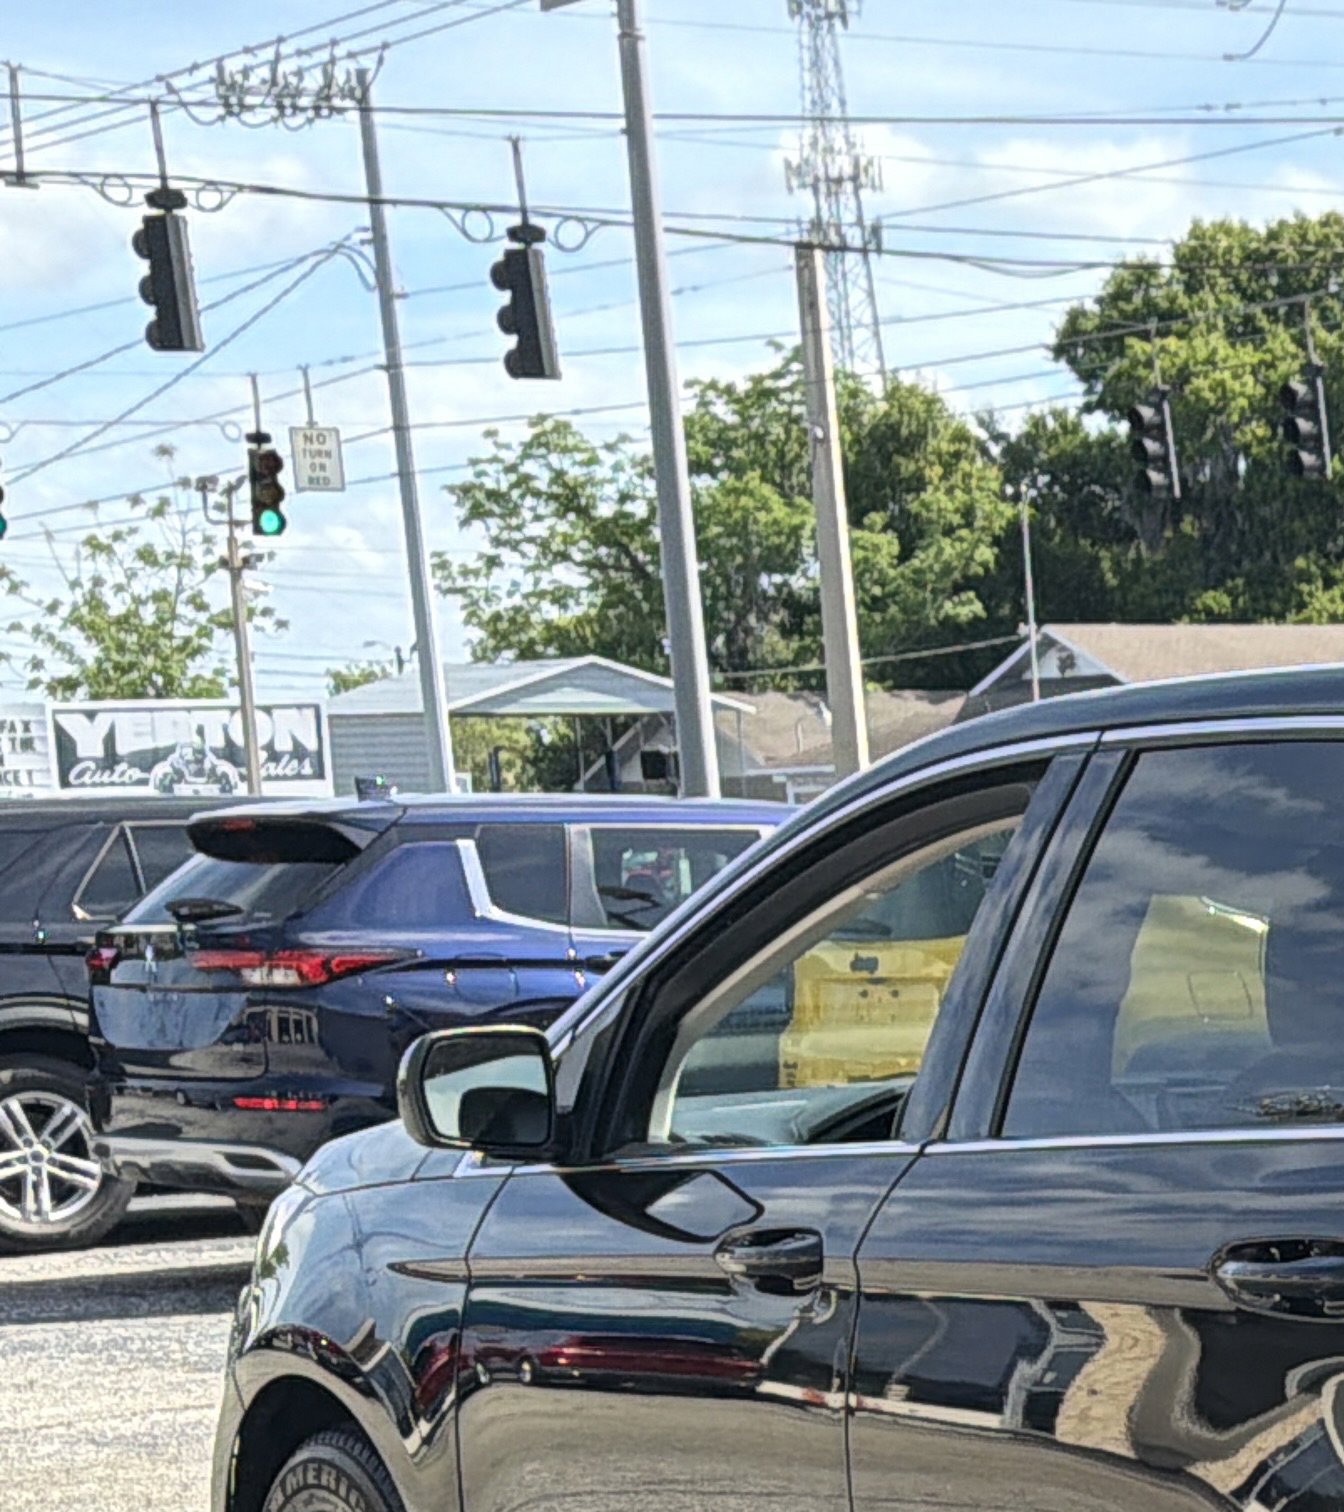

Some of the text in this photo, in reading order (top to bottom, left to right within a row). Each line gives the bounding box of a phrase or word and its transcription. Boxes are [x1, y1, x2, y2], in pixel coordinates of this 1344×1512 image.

[302, 432, 327, 446] NO
[302, 447, 332, 460] TURN
[308, 461, 327, 473] ON
[307, 475, 331, 487] RED
[68, 760, 141, 786] Auto
